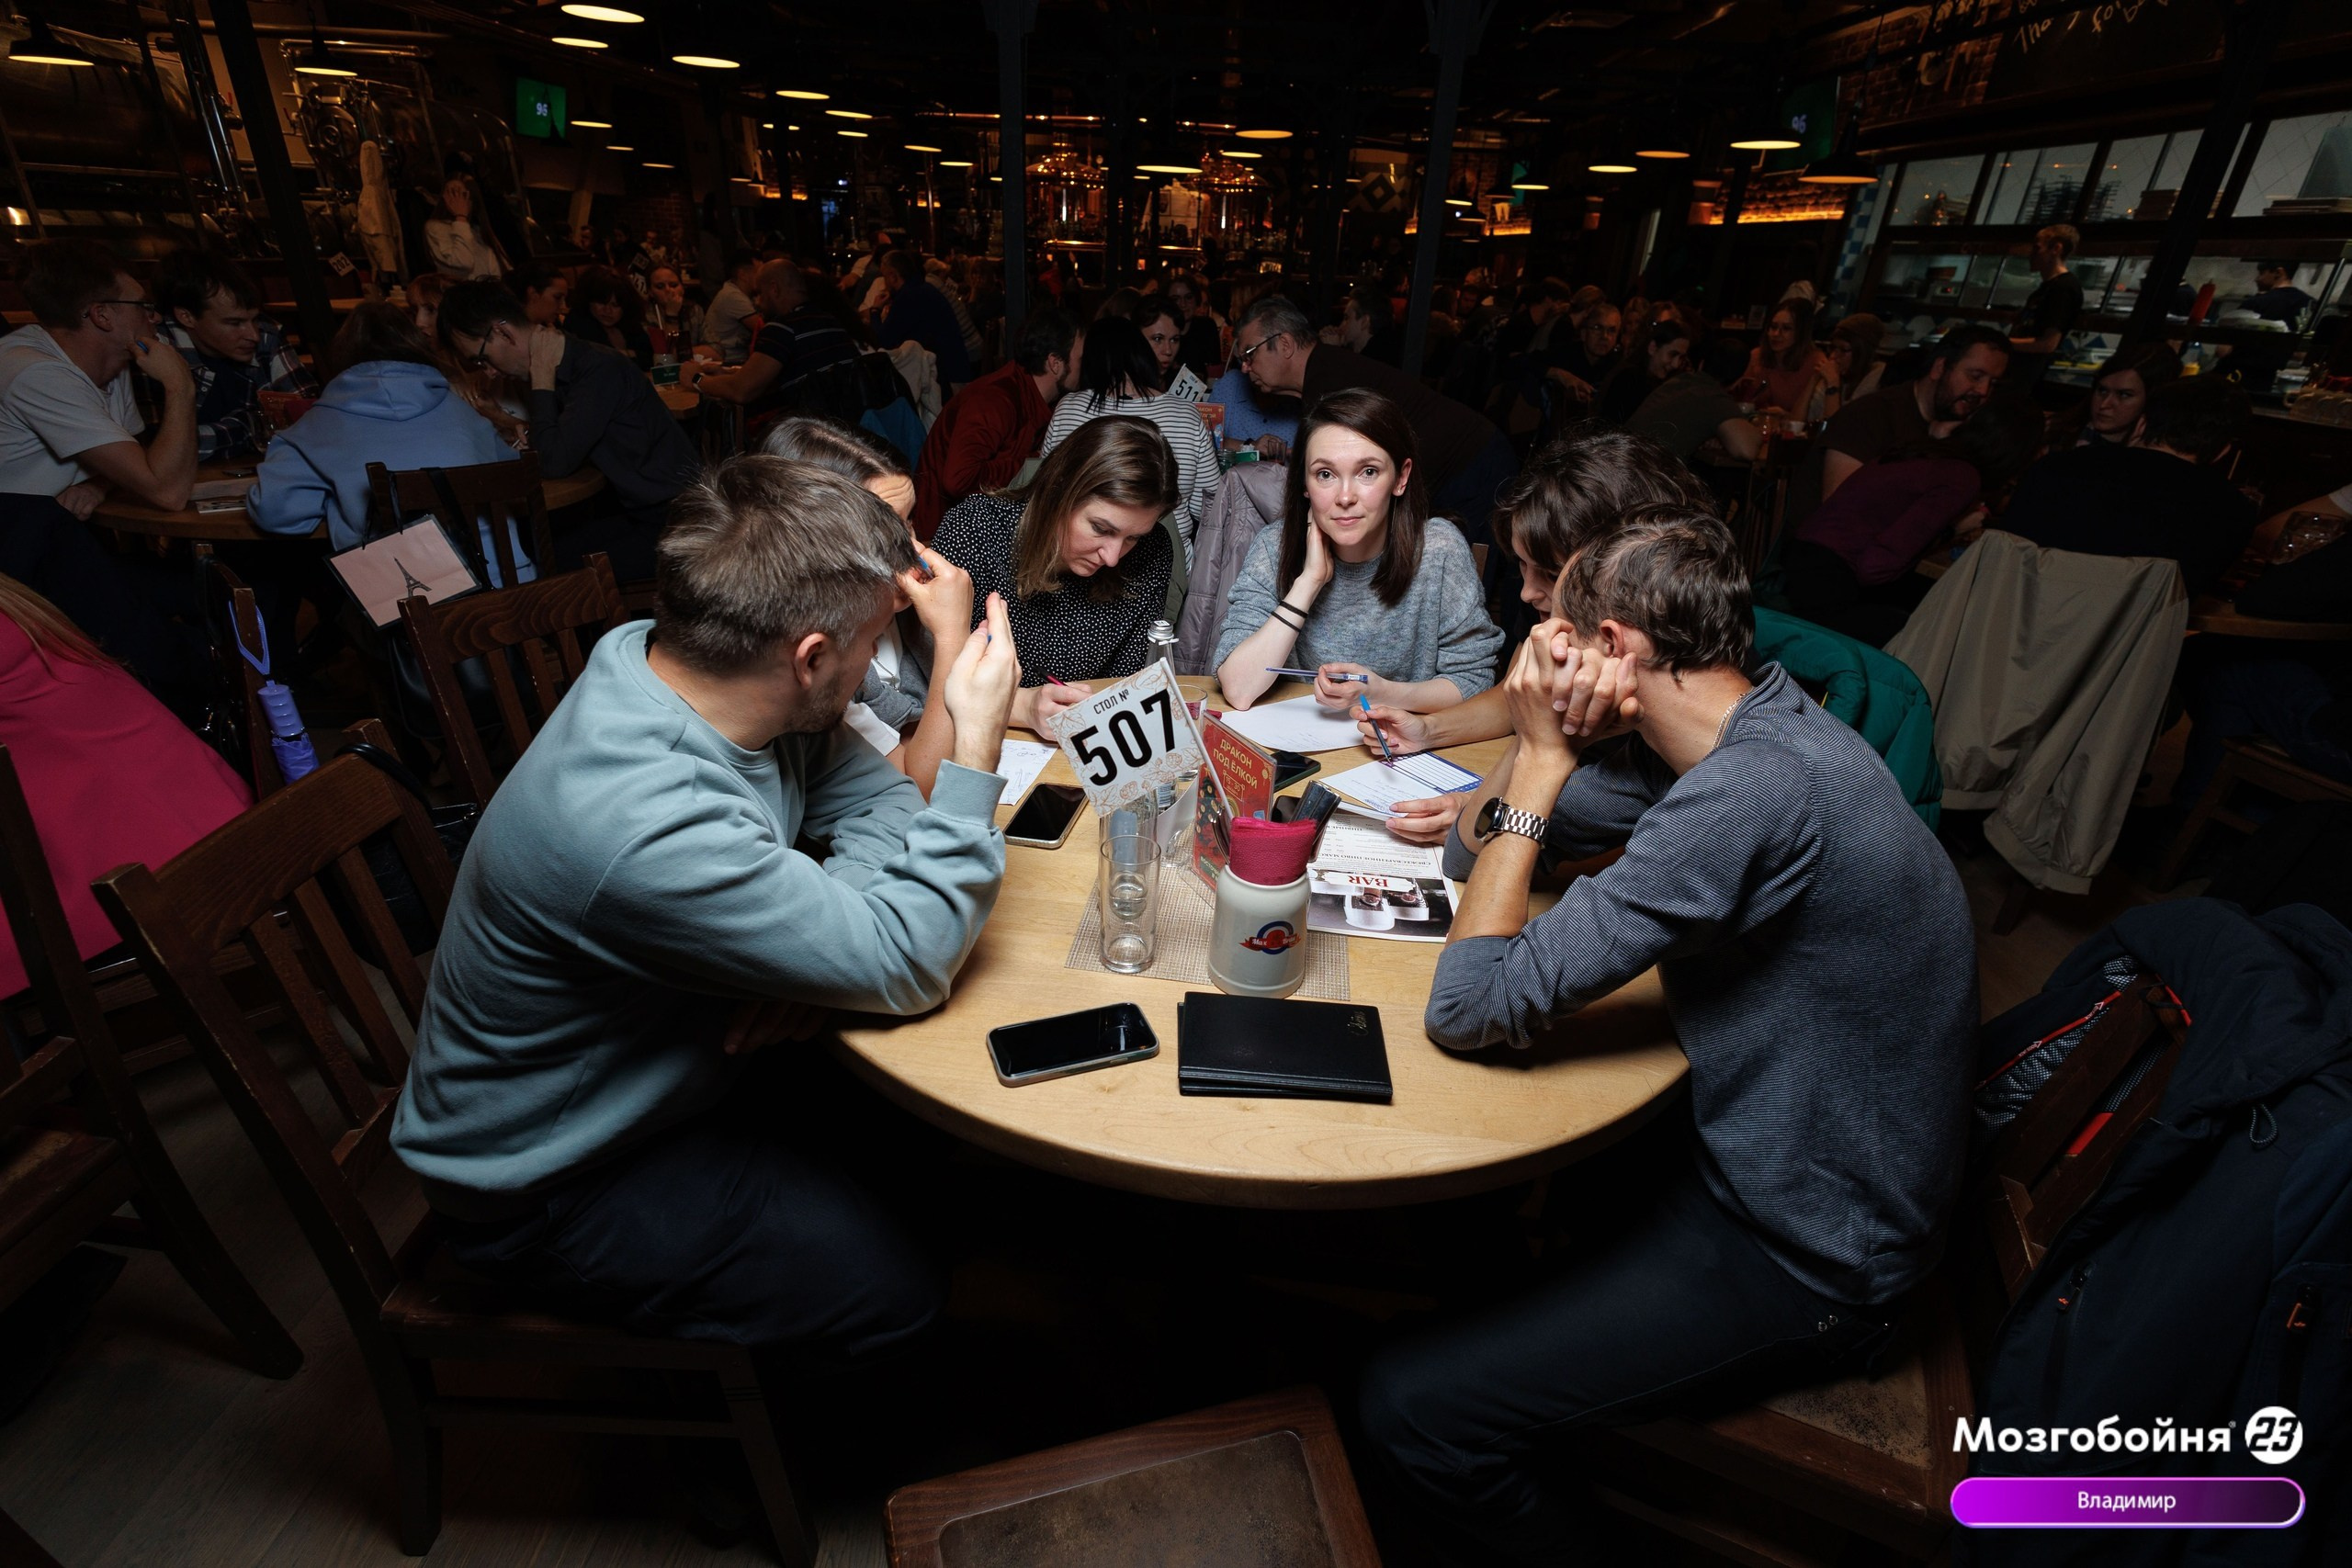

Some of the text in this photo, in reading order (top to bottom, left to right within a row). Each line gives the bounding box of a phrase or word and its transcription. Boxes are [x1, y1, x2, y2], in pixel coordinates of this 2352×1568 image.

[1792, 114, 1807, 134] 96
[1176, 379, 1199, 401] 511
[1093, 695, 1118, 715] СТОЛ
[1070, 688, 1175, 786] 507
[1220, 739, 1252, 770] ДРАКОН
[1213, 749, 1258, 789] ПОД ЁЛКОЙ
[1347, 875, 1389, 887] BAR
